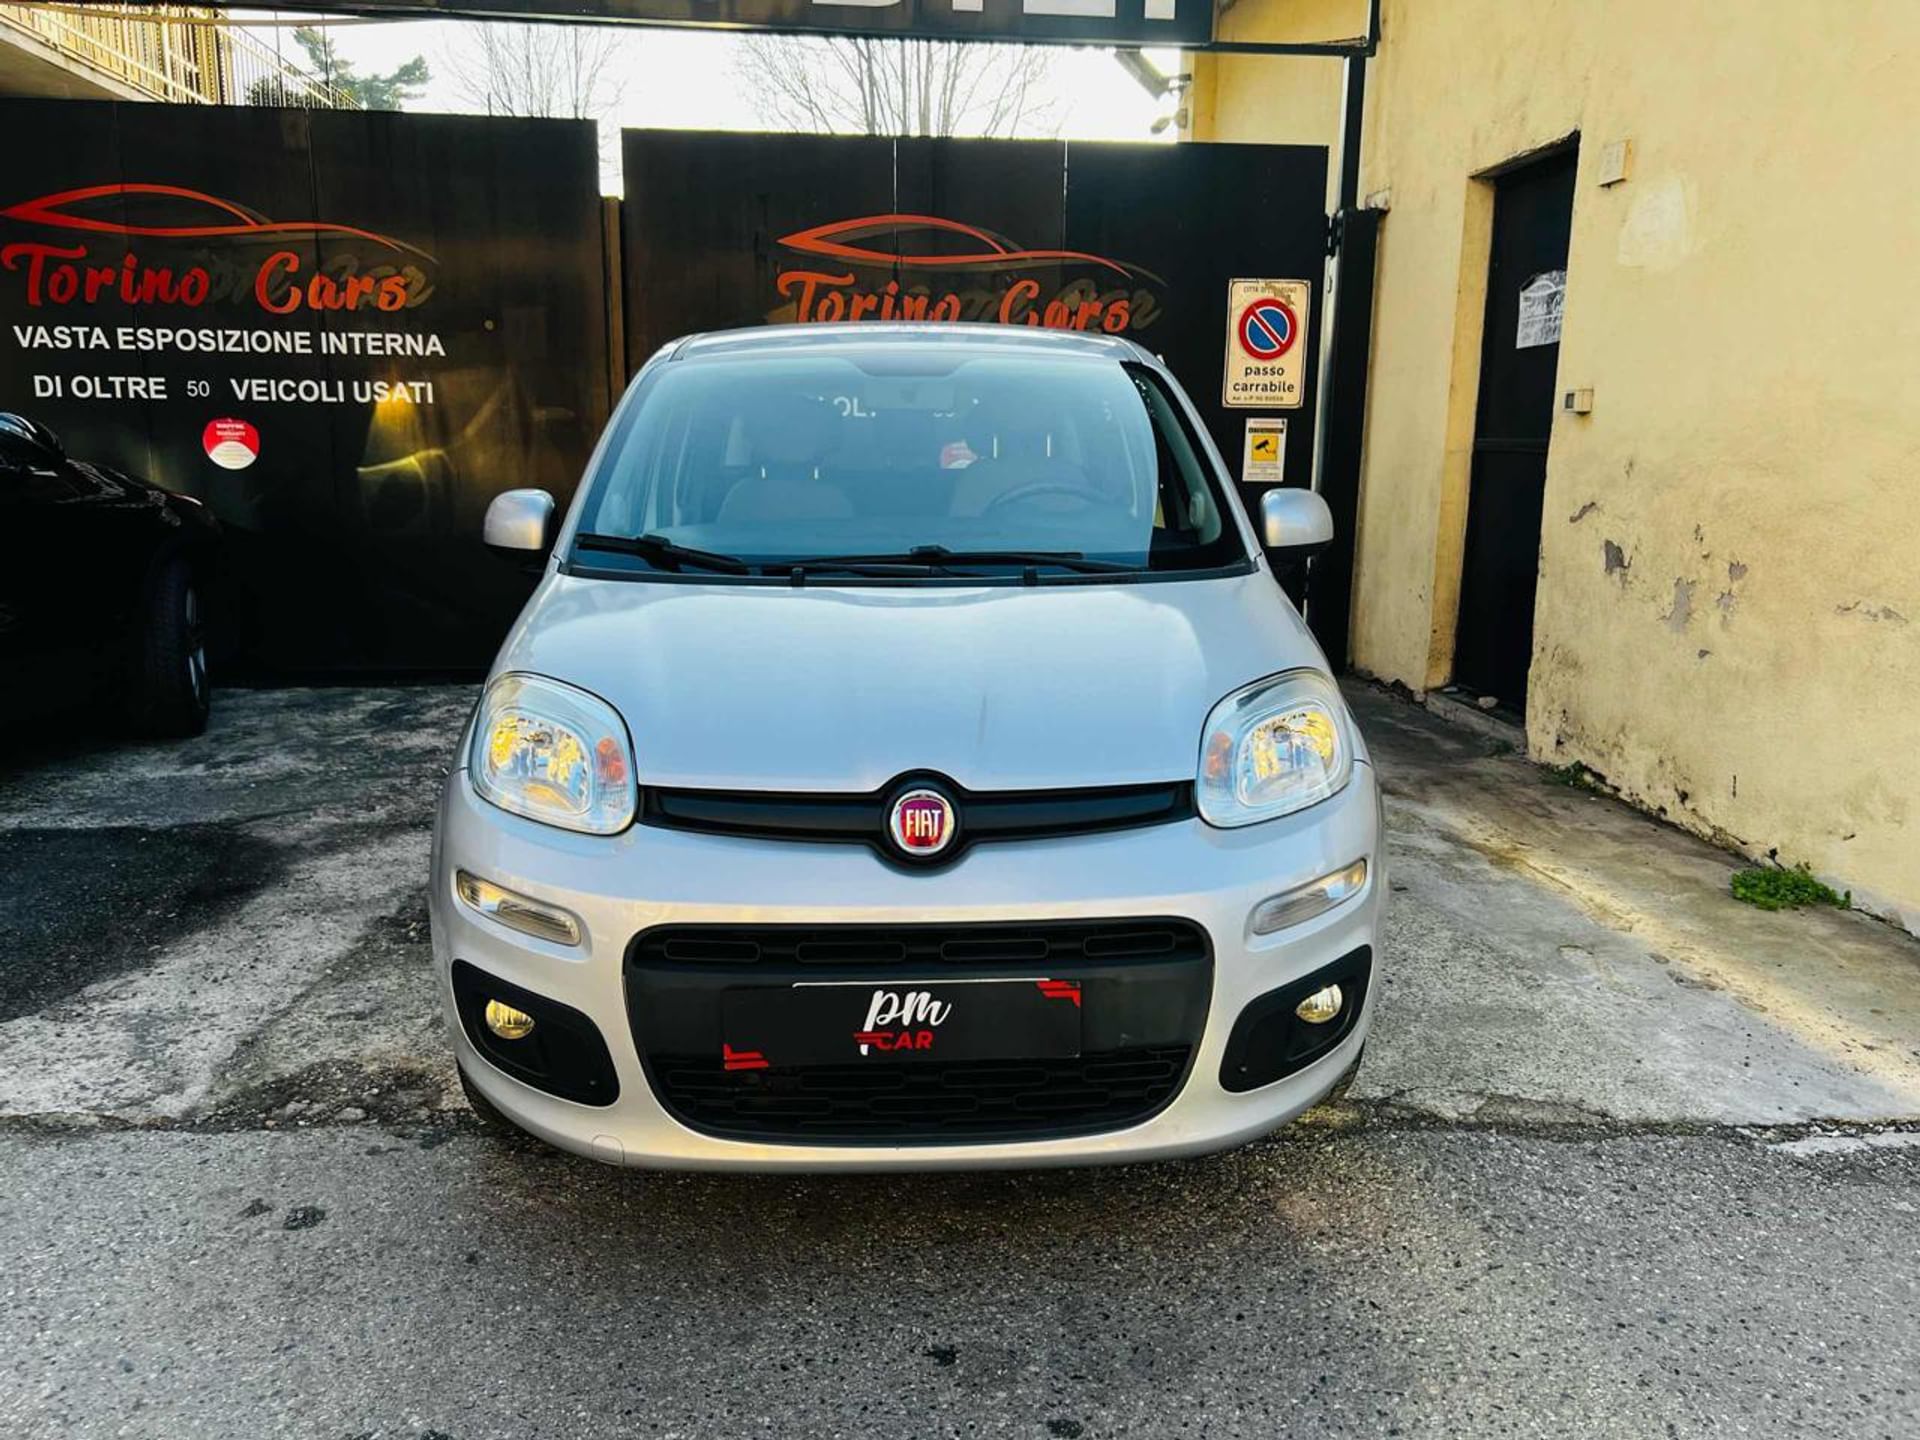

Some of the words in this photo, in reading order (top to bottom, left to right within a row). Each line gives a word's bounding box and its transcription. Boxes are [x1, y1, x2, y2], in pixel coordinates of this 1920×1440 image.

[2, 243, 210, 307] Torino
[255, 251, 409, 314] Cars
[777, 271, 961, 323] Torino
[1000, 279, 1130, 333] Cars
[13, 325, 110, 350] VASTA
[117, 327, 313, 354] ESPOSIZIONE
[320, 331, 446, 357] INTERNA
[1244, 366, 1285, 378] passo
[33, 375, 63, 398] DI
[70, 376, 168, 399] OLTRE
[186, 380, 211, 398] 50
[230, 378, 345, 403] VEICOLI
[353, 380, 434, 404] USATI
[1233, 381, 1295, 393] carrabile
[906, 809, 942, 837] FIAT
[860, 990, 952, 1056] pm
[854, 1030, 934, 1050] CAR
